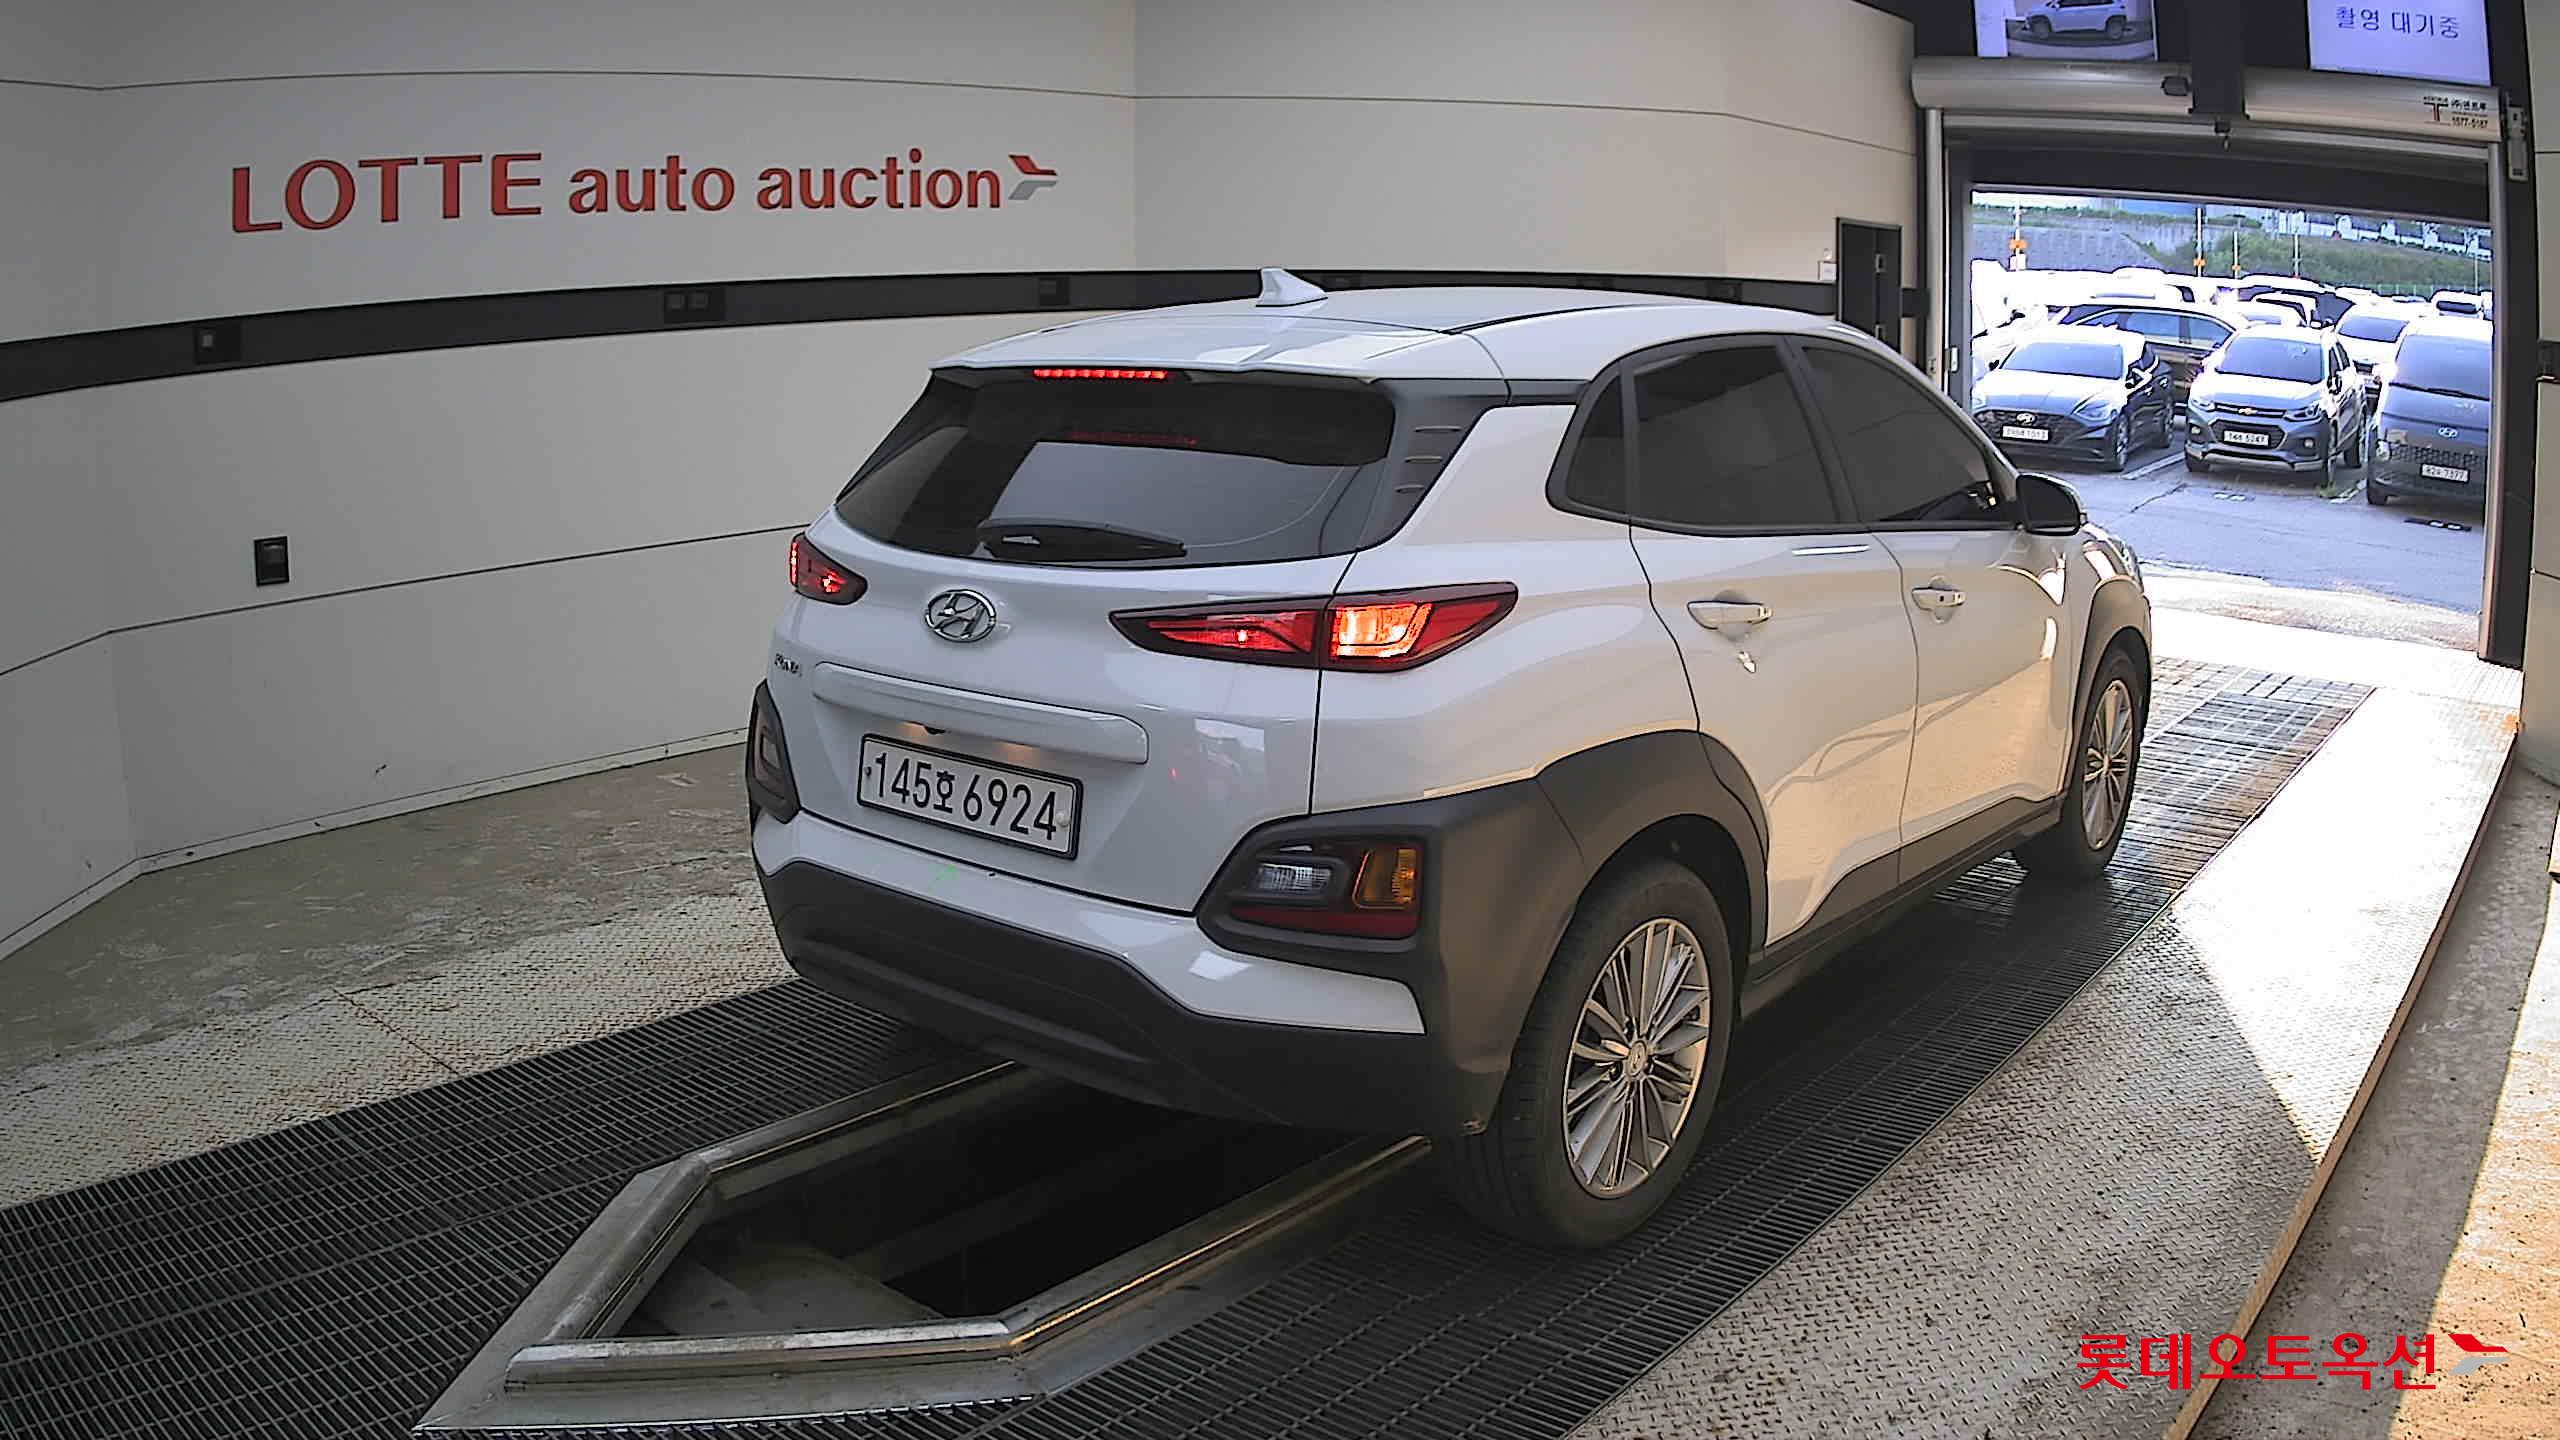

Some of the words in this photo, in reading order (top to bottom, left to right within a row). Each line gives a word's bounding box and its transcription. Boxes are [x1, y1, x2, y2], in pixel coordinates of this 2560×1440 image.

[2336, 6, 2380, 31] 촬영
[2391, 12, 2459, 39] 대기중
[232, 152, 542, 234] LOTTE
[568, 155, 735, 213] auto
[757, 148, 1000, 212] auction
